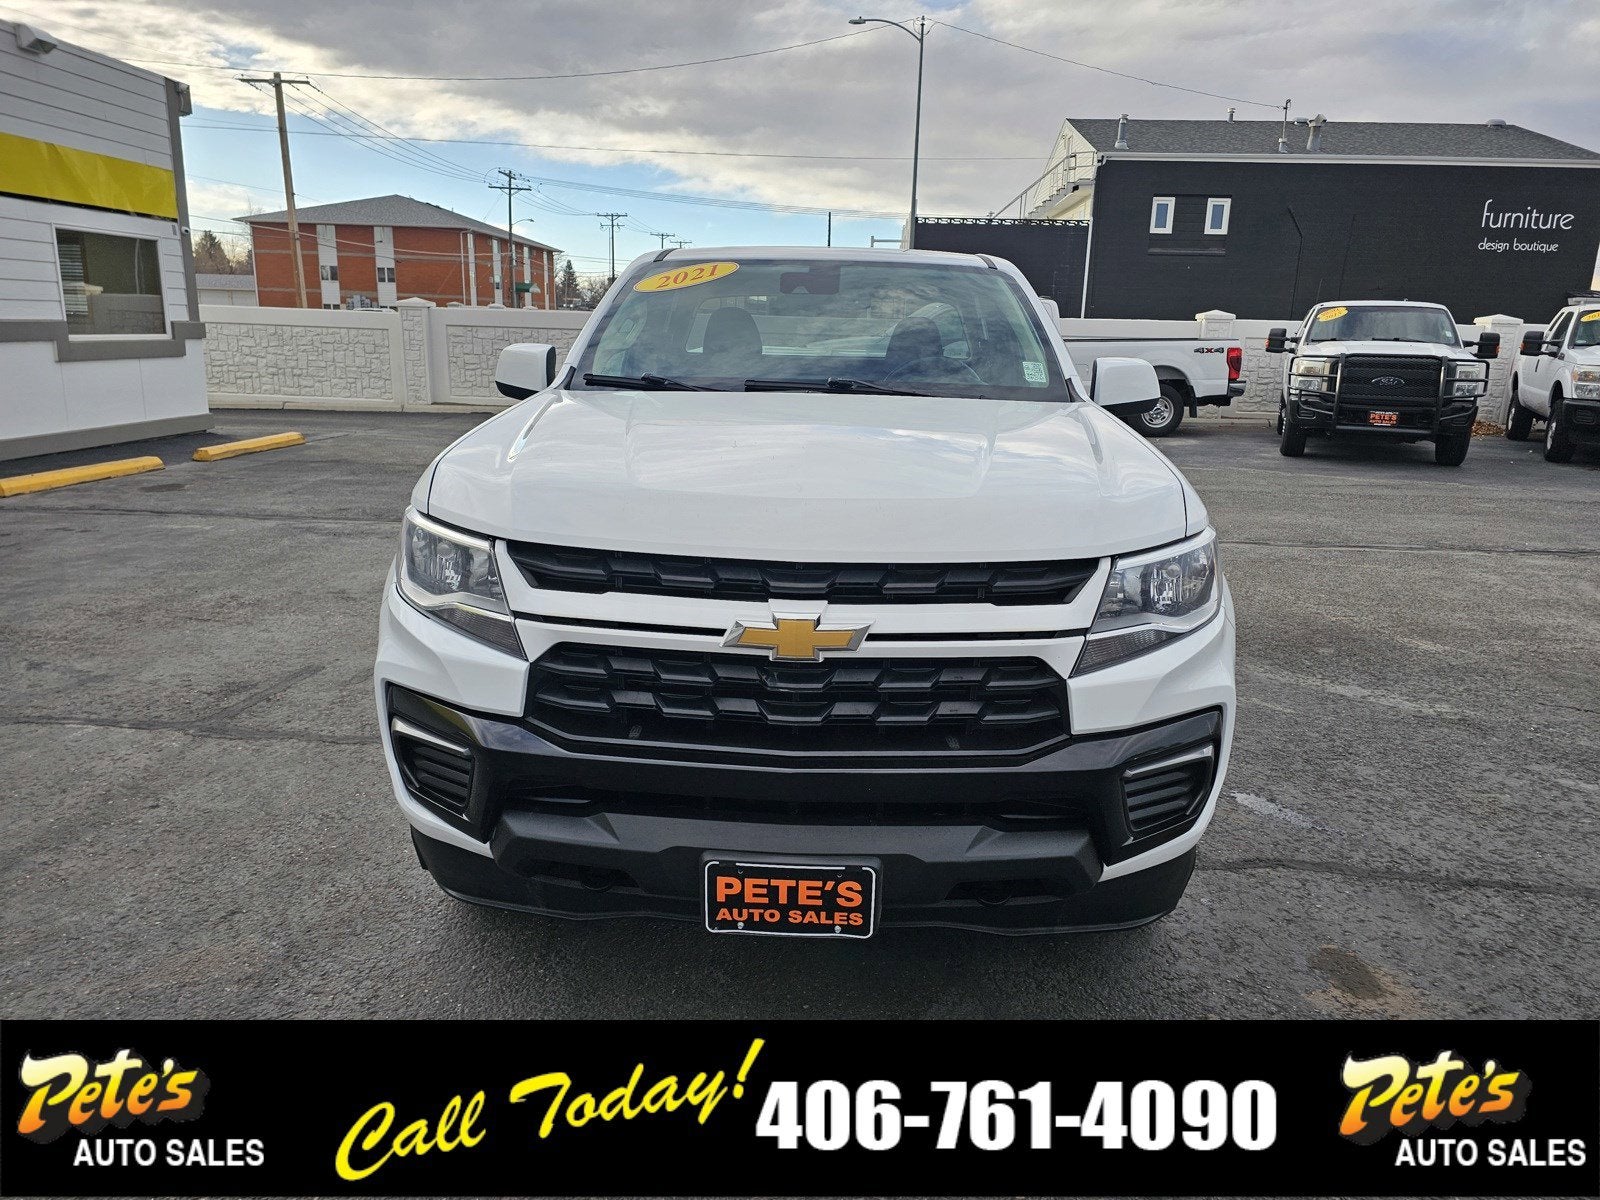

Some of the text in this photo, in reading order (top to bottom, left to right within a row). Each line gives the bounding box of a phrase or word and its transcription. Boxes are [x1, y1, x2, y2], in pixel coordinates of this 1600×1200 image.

[1481, 199, 1575, 230] furniture
[1478, 237, 1559, 254] design boutique
[656, 264, 718, 289] 2021
[716, 876, 863, 907] PETE'S
[715, 908, 864, 926] AUTO SALES
